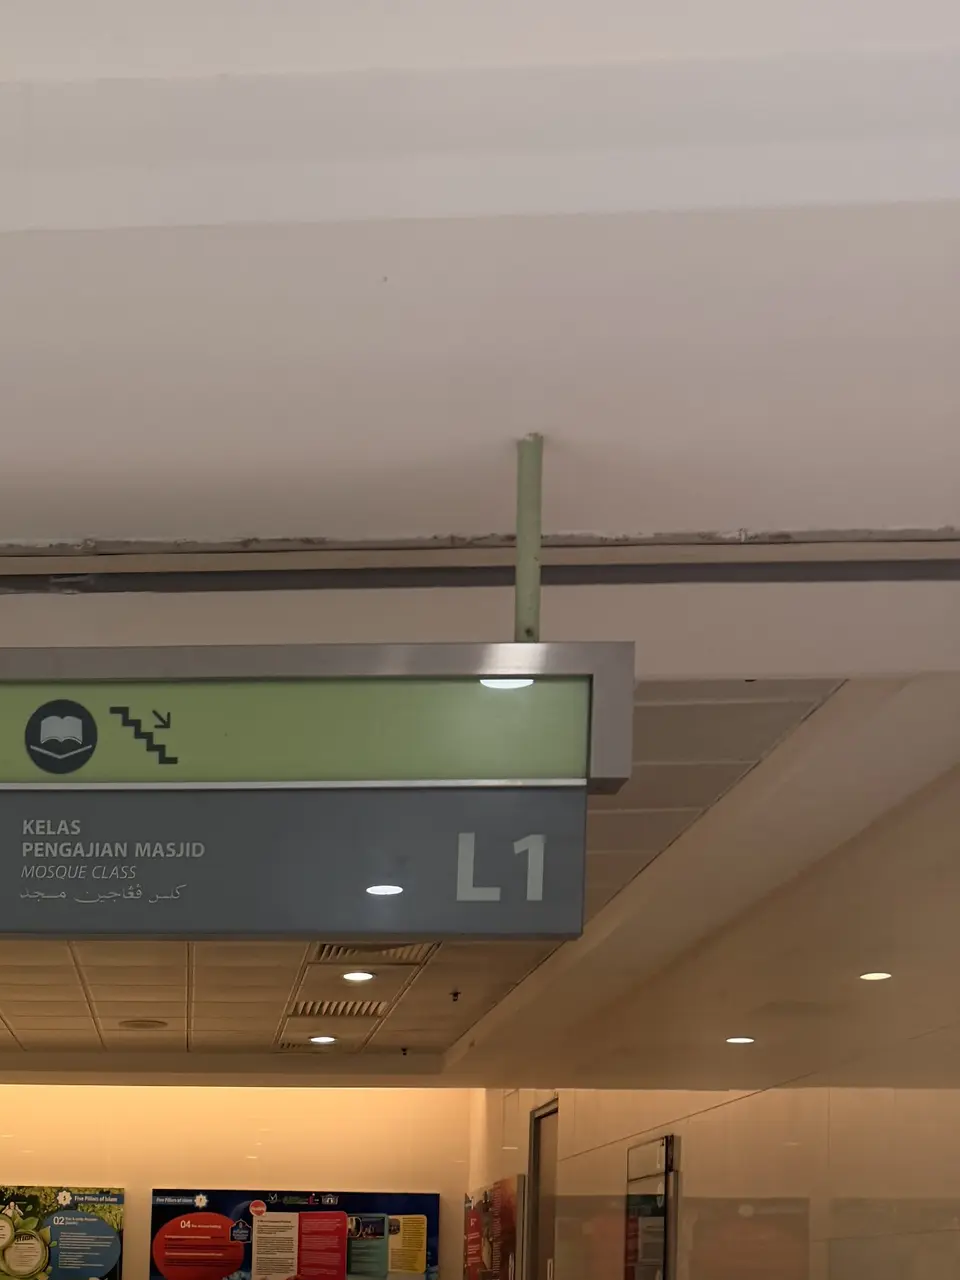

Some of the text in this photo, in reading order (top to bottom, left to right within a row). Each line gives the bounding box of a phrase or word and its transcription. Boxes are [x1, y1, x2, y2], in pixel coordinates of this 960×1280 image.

[22, 819, 81, 836] KELAS
[22, 842, 206, 858] PENGAJIAN MASJID
[20, 865, 137, 879] MOSQUE CLASS
[456, 831, 547, 901] L1
[53, 1216, 65, 1225] 02
[180, 1219, 191, 1228] 04
